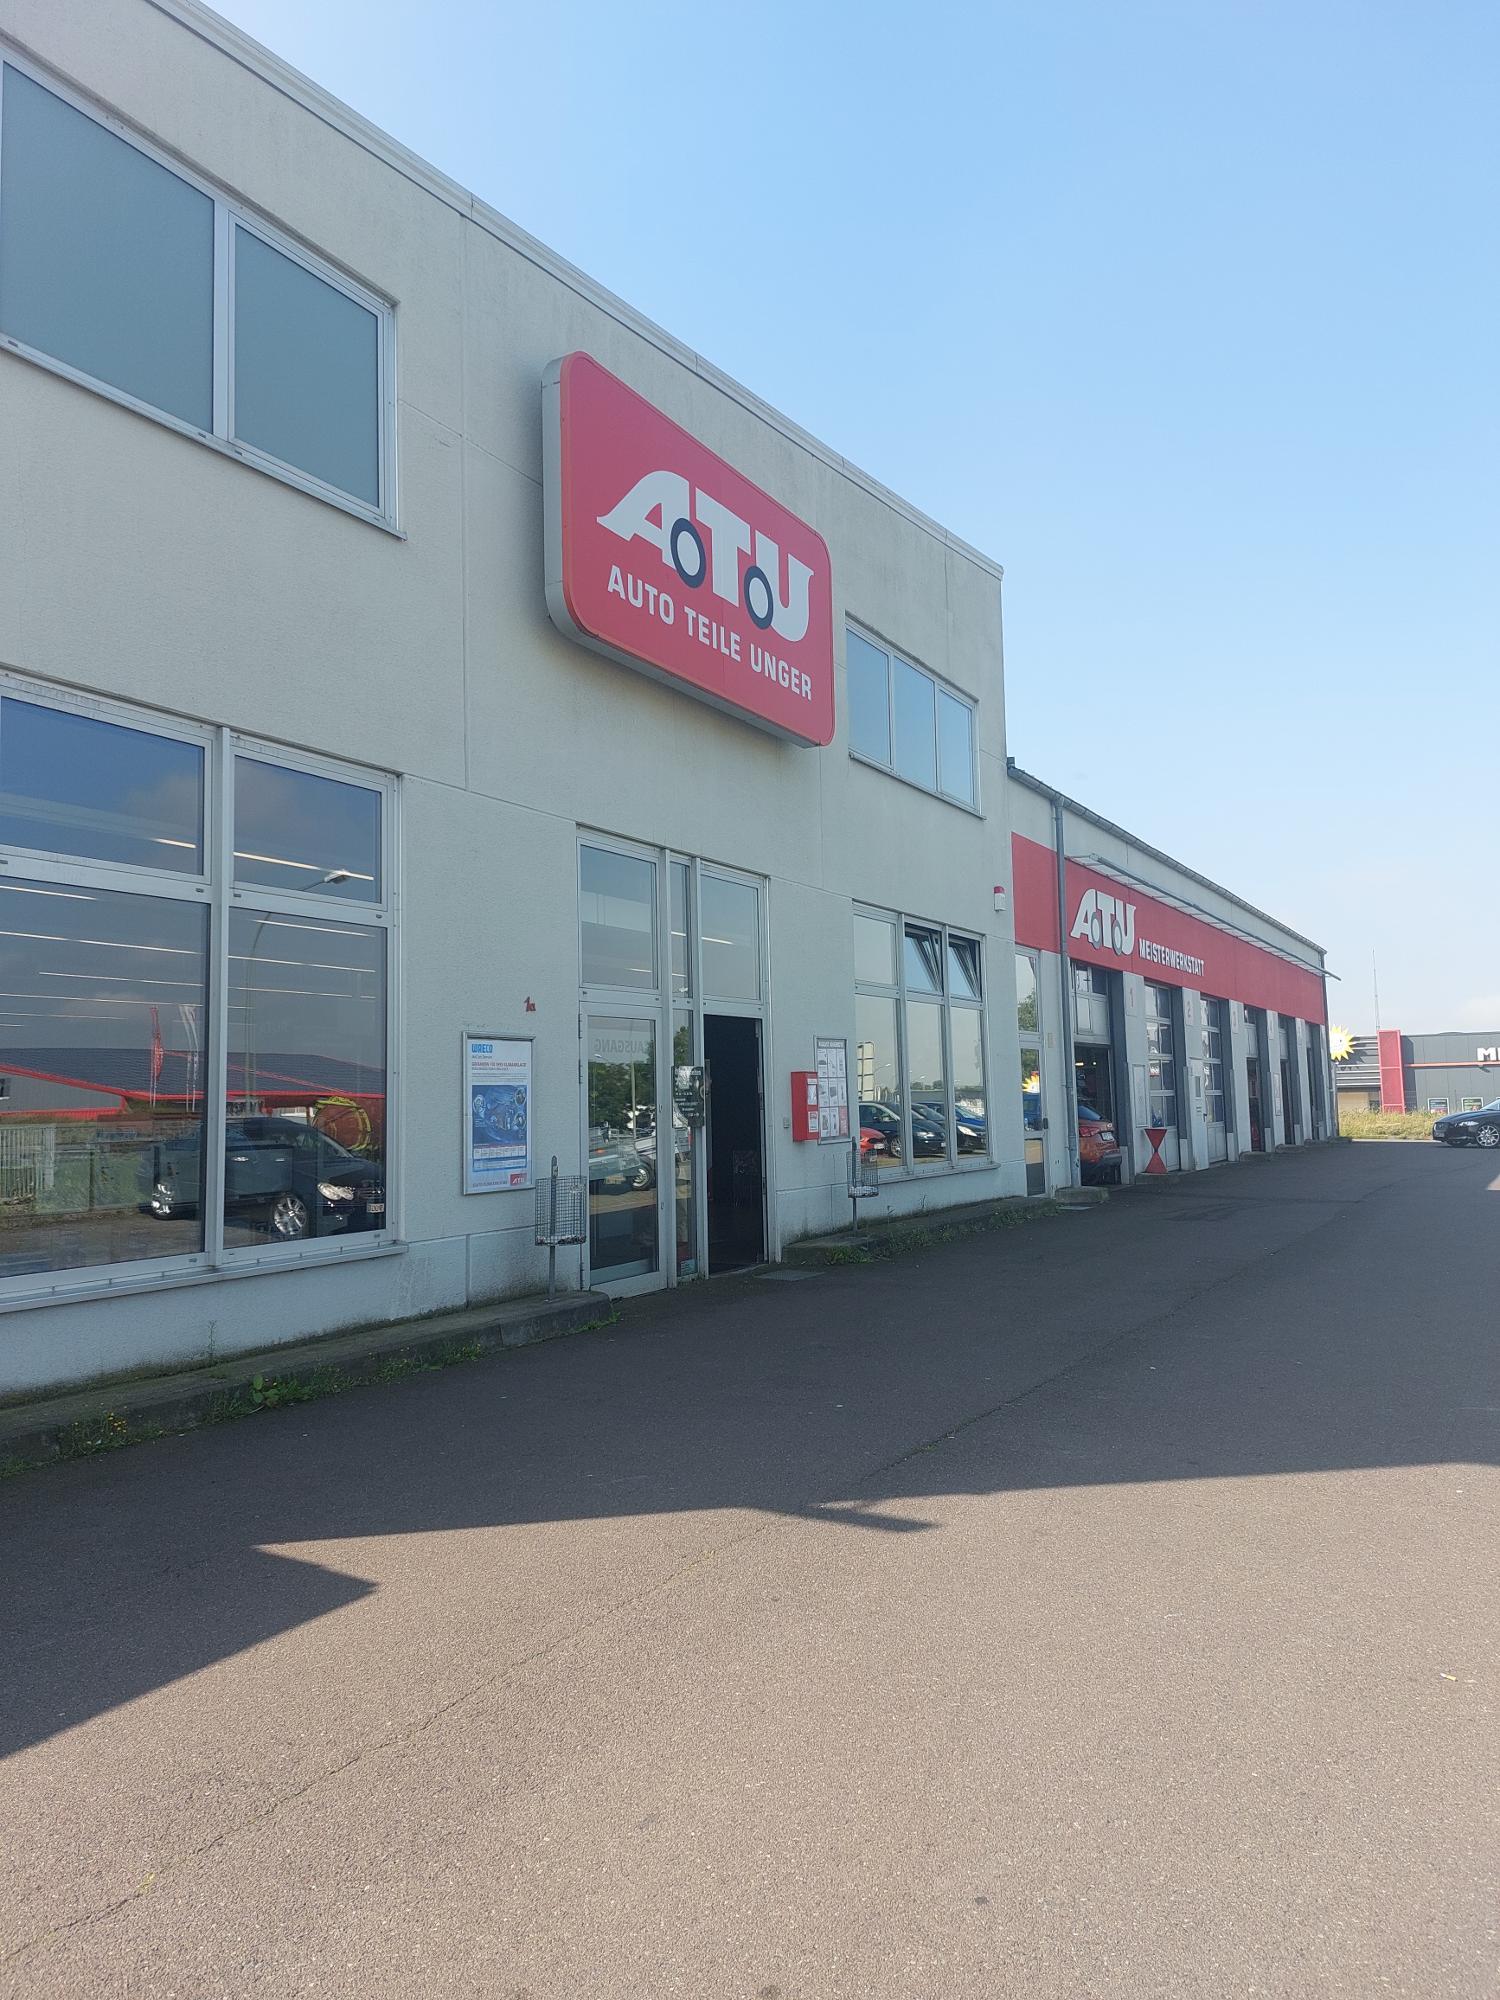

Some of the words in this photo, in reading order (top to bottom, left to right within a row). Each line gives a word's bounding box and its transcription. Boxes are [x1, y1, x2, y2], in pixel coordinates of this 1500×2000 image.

[607, 564, 675, 625] AUTO
[684, 606, 741, 662] TEILE
[750, 643, 812, 701] UNGER
[1070, 888, 1137, 956] ATU
[1139, 938, 1205, 977] MEISTERWERKSTATT
